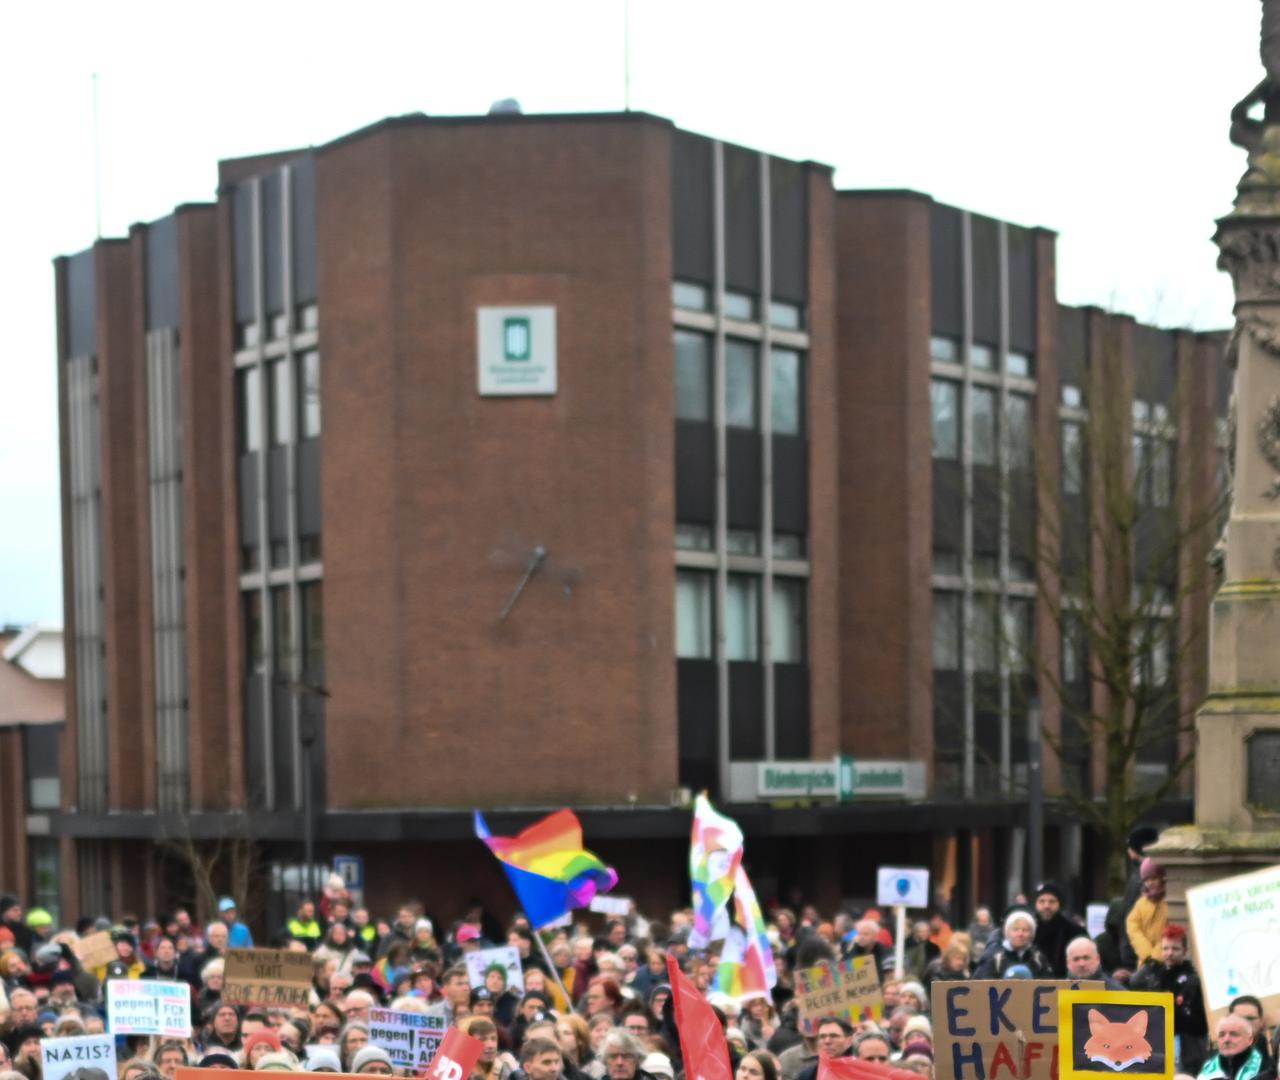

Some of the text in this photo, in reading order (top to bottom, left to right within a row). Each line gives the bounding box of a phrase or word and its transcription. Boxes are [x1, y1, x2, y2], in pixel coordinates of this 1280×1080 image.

[370, 1010, 444, 1029] OSTFRIESEN
[947, 986, 1057, 1037] EKE
[46, 1045, 111, 1062] NAZIS?
